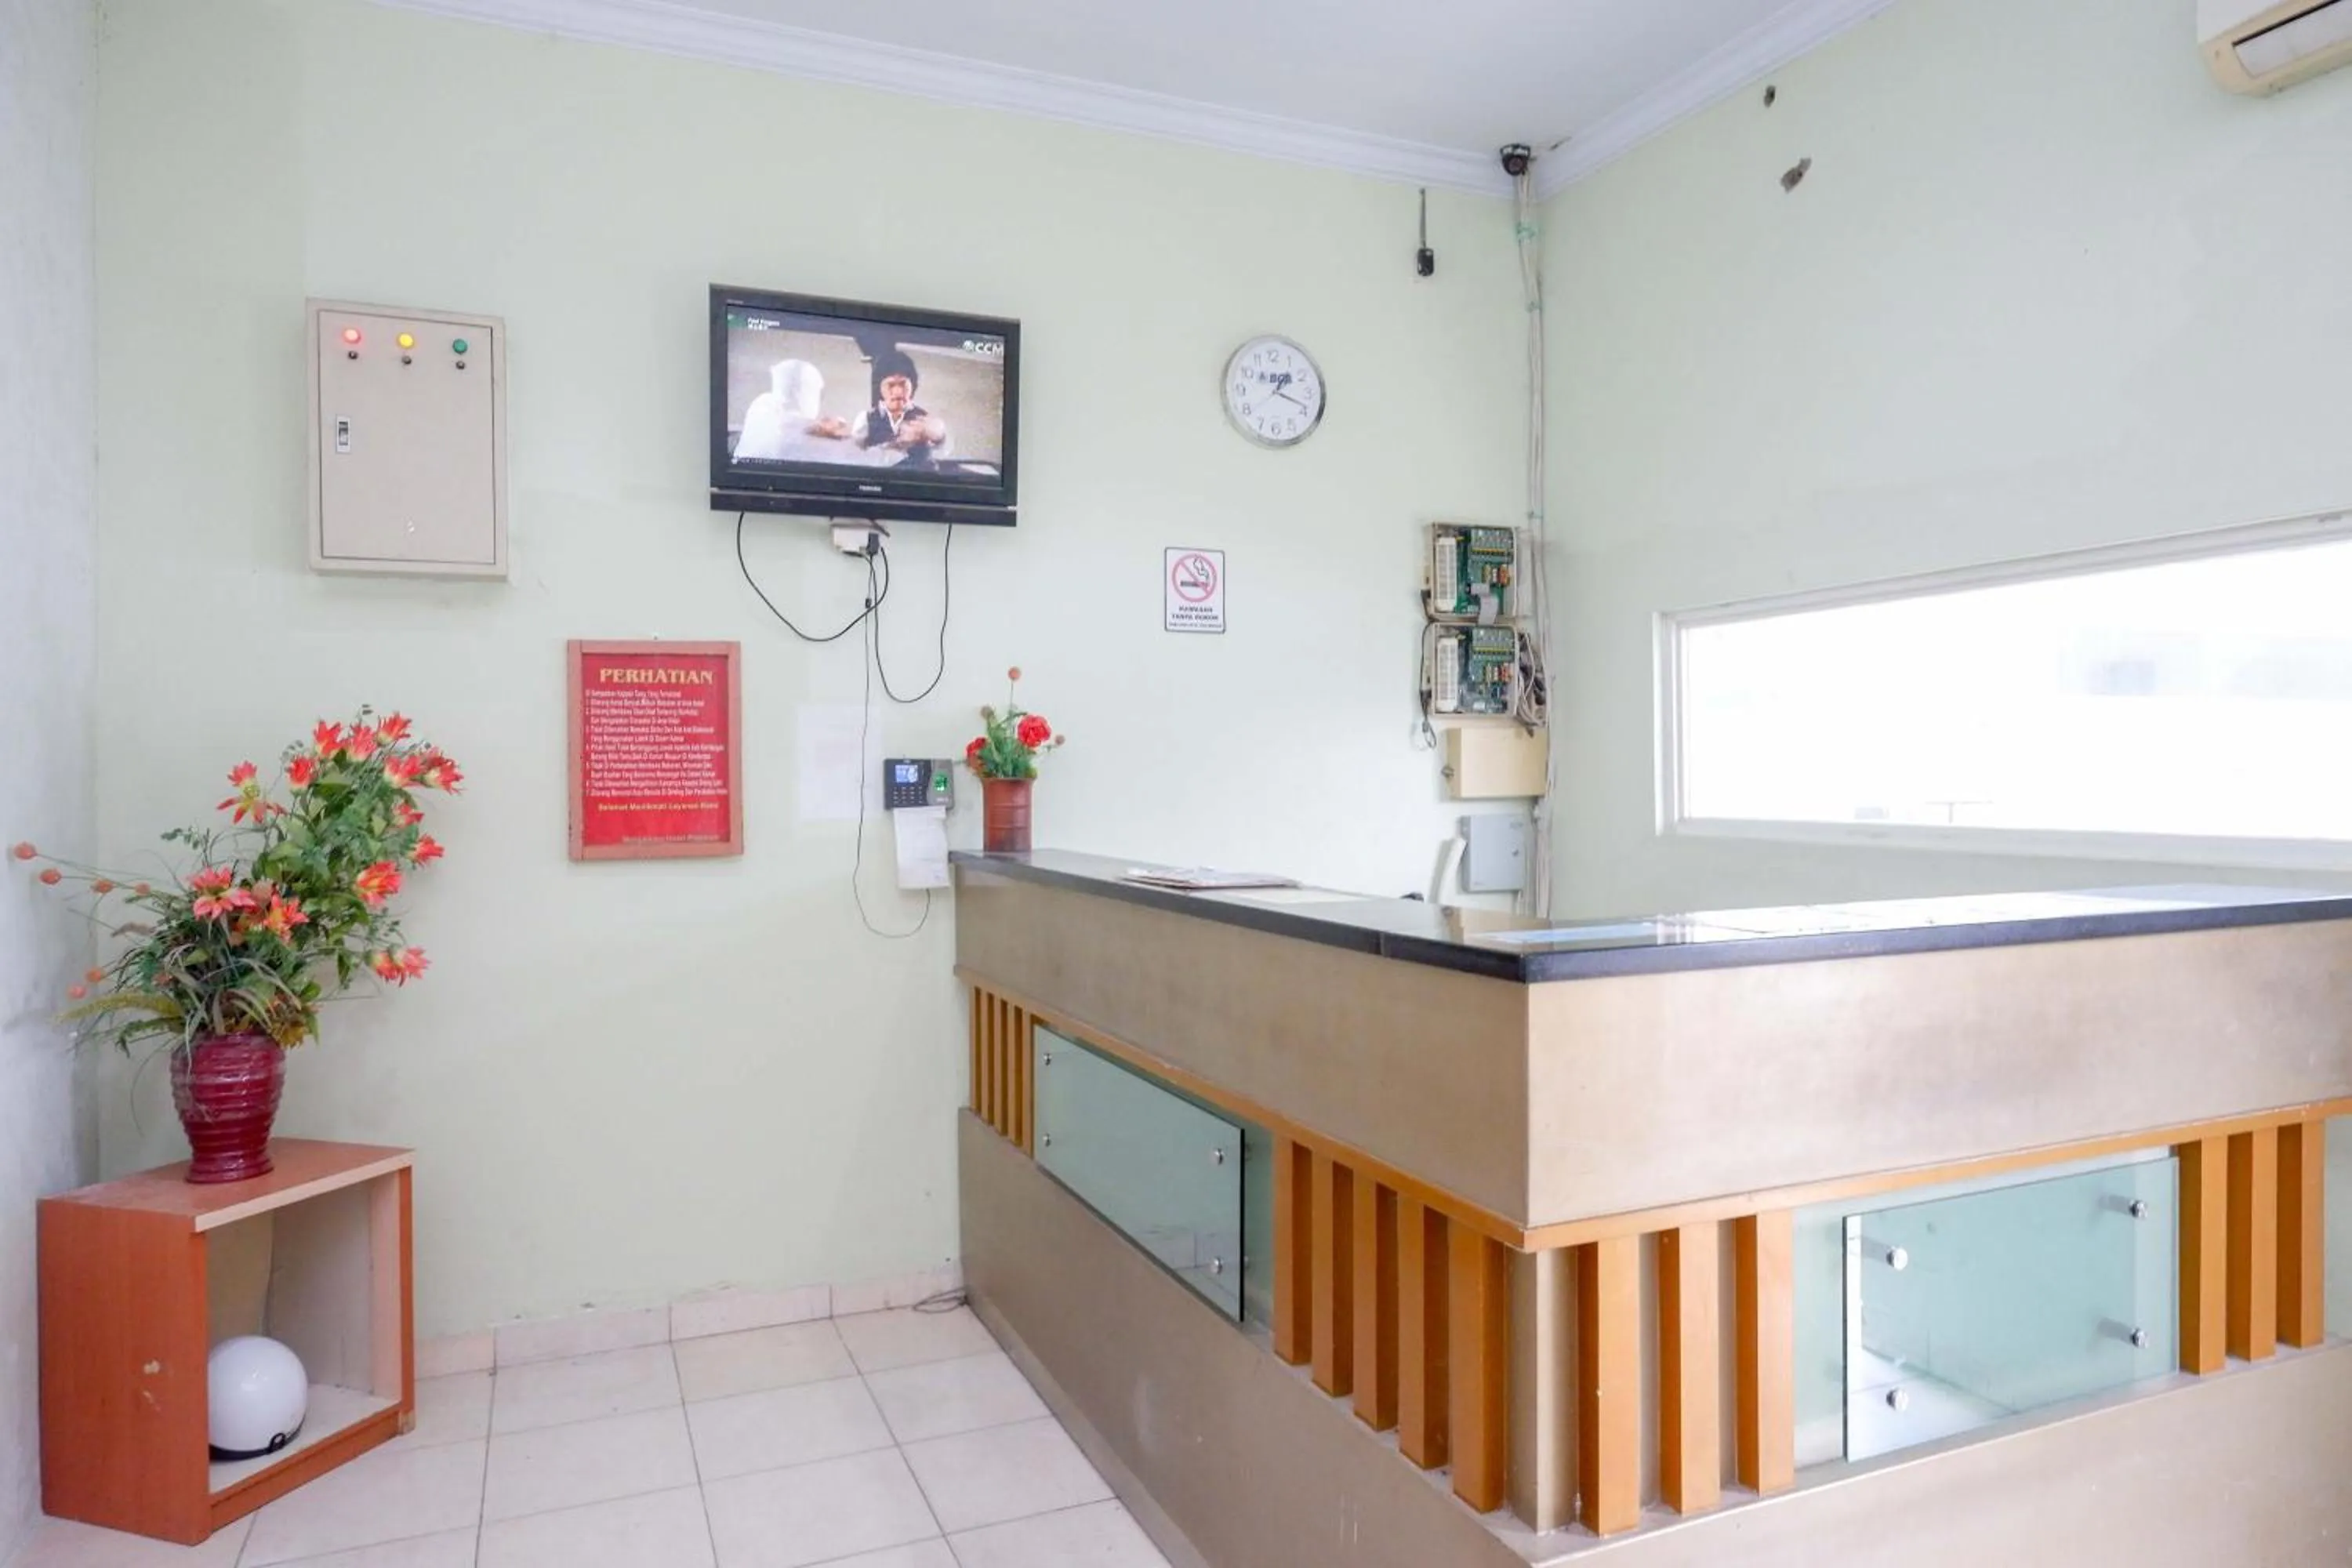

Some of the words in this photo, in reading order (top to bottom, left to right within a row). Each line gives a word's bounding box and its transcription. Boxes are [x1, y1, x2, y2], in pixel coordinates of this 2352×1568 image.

[1254, 354, 1261, 367] 11
[1266, 349, 1279, 363] 12
[1242, 366, 1254, 379] 10
[1297, 368, 1306, 382] 2
[1243, 402, 1251, 416] 8
[1258, 416, 1265, 430] 7
[1271, 422, 1281, 436] 6
[599, 667, 713, 684] PERHATIAN
